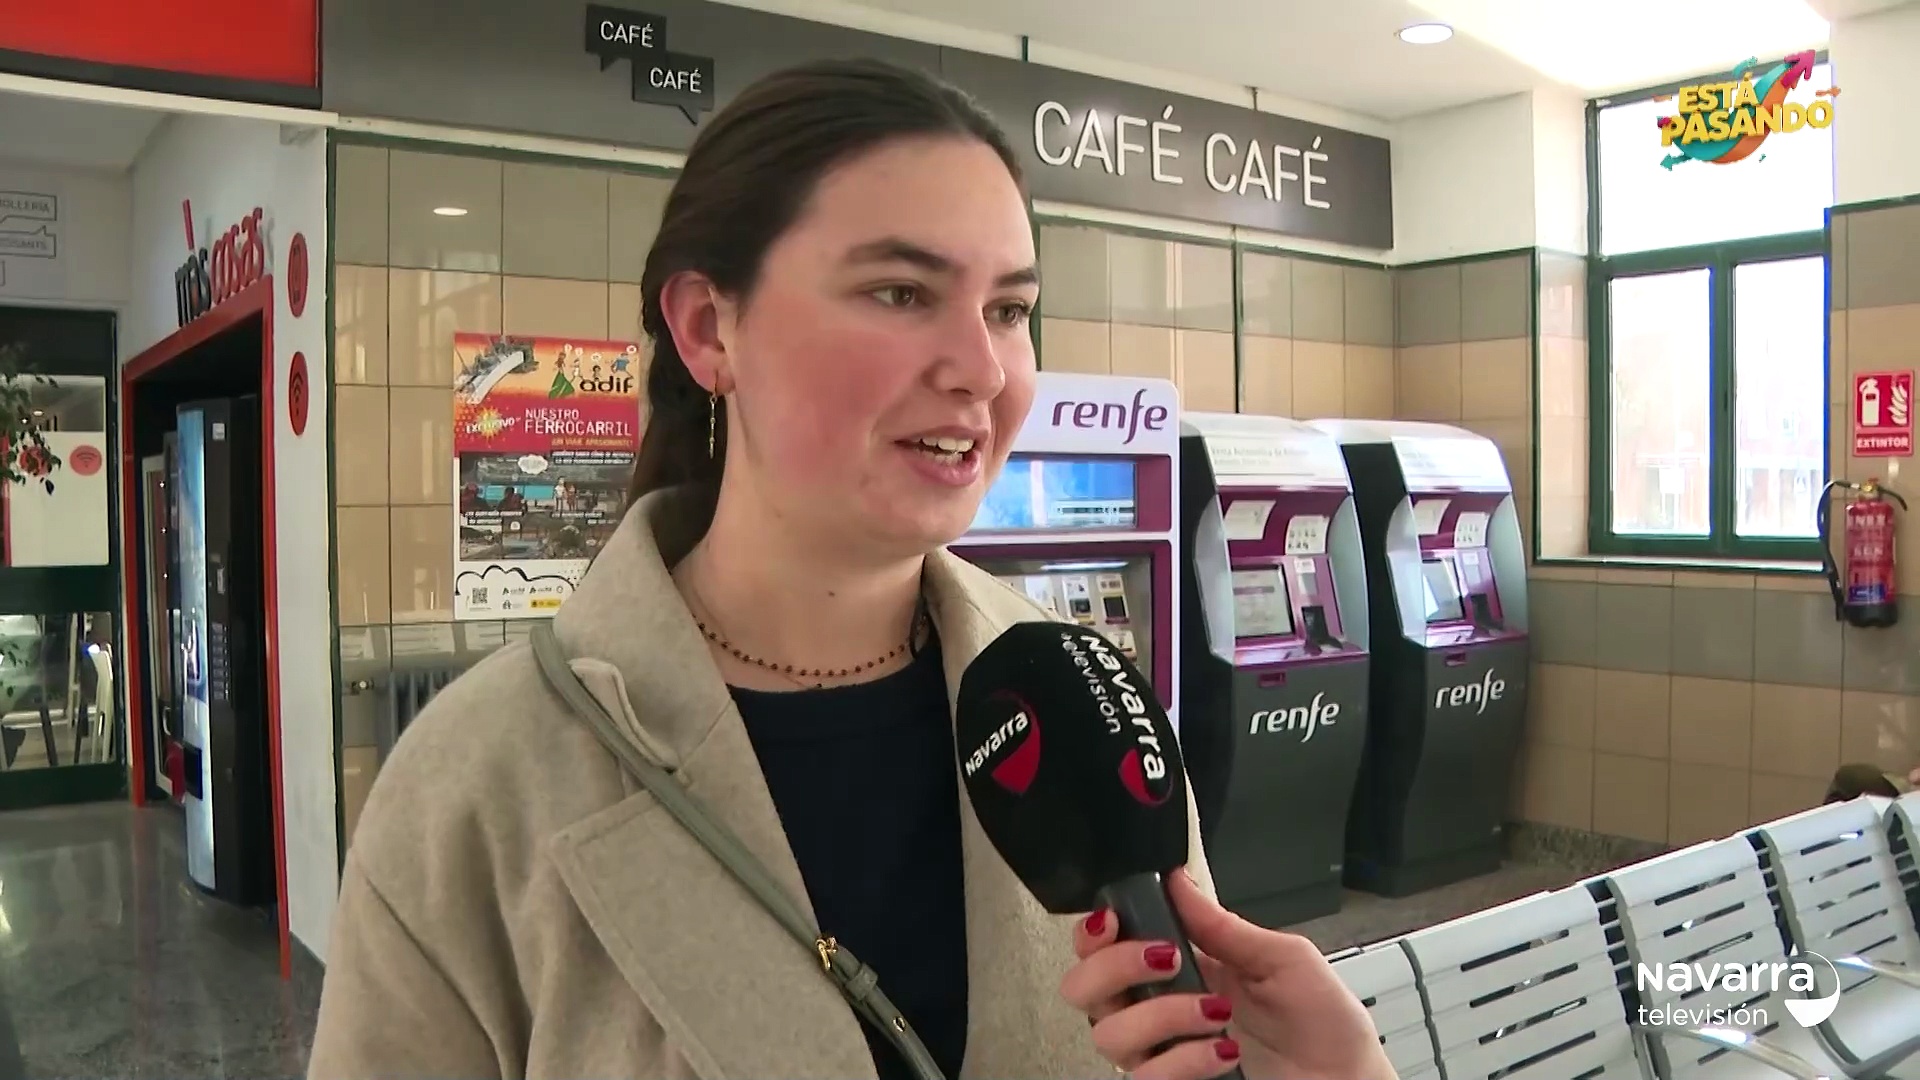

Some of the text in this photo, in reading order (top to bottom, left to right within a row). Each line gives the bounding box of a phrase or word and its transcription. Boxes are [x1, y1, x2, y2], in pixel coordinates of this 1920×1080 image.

[600, 20, 654, 48] CAFÉ
[650, 67, 702, 94] CAFÉ
[1034, 101, 1331, 209] CAFÉ CAFÉ
[579, 376, 634, 394] adif
[525, 408, 580, 421] NUESTRO
[525, 420, 632, 436] FERROCARRIL
[1052, 388, 1168, 445] renfe
[1857, 437, 1909, 448] EXTINTOR
[1080, 635, 1166, 780] Navarra
[1435, 668, 1505, 716] renfe
[1250, 691, 1340, 743] renfe
[965, 711, 1029, 776] Navarra
